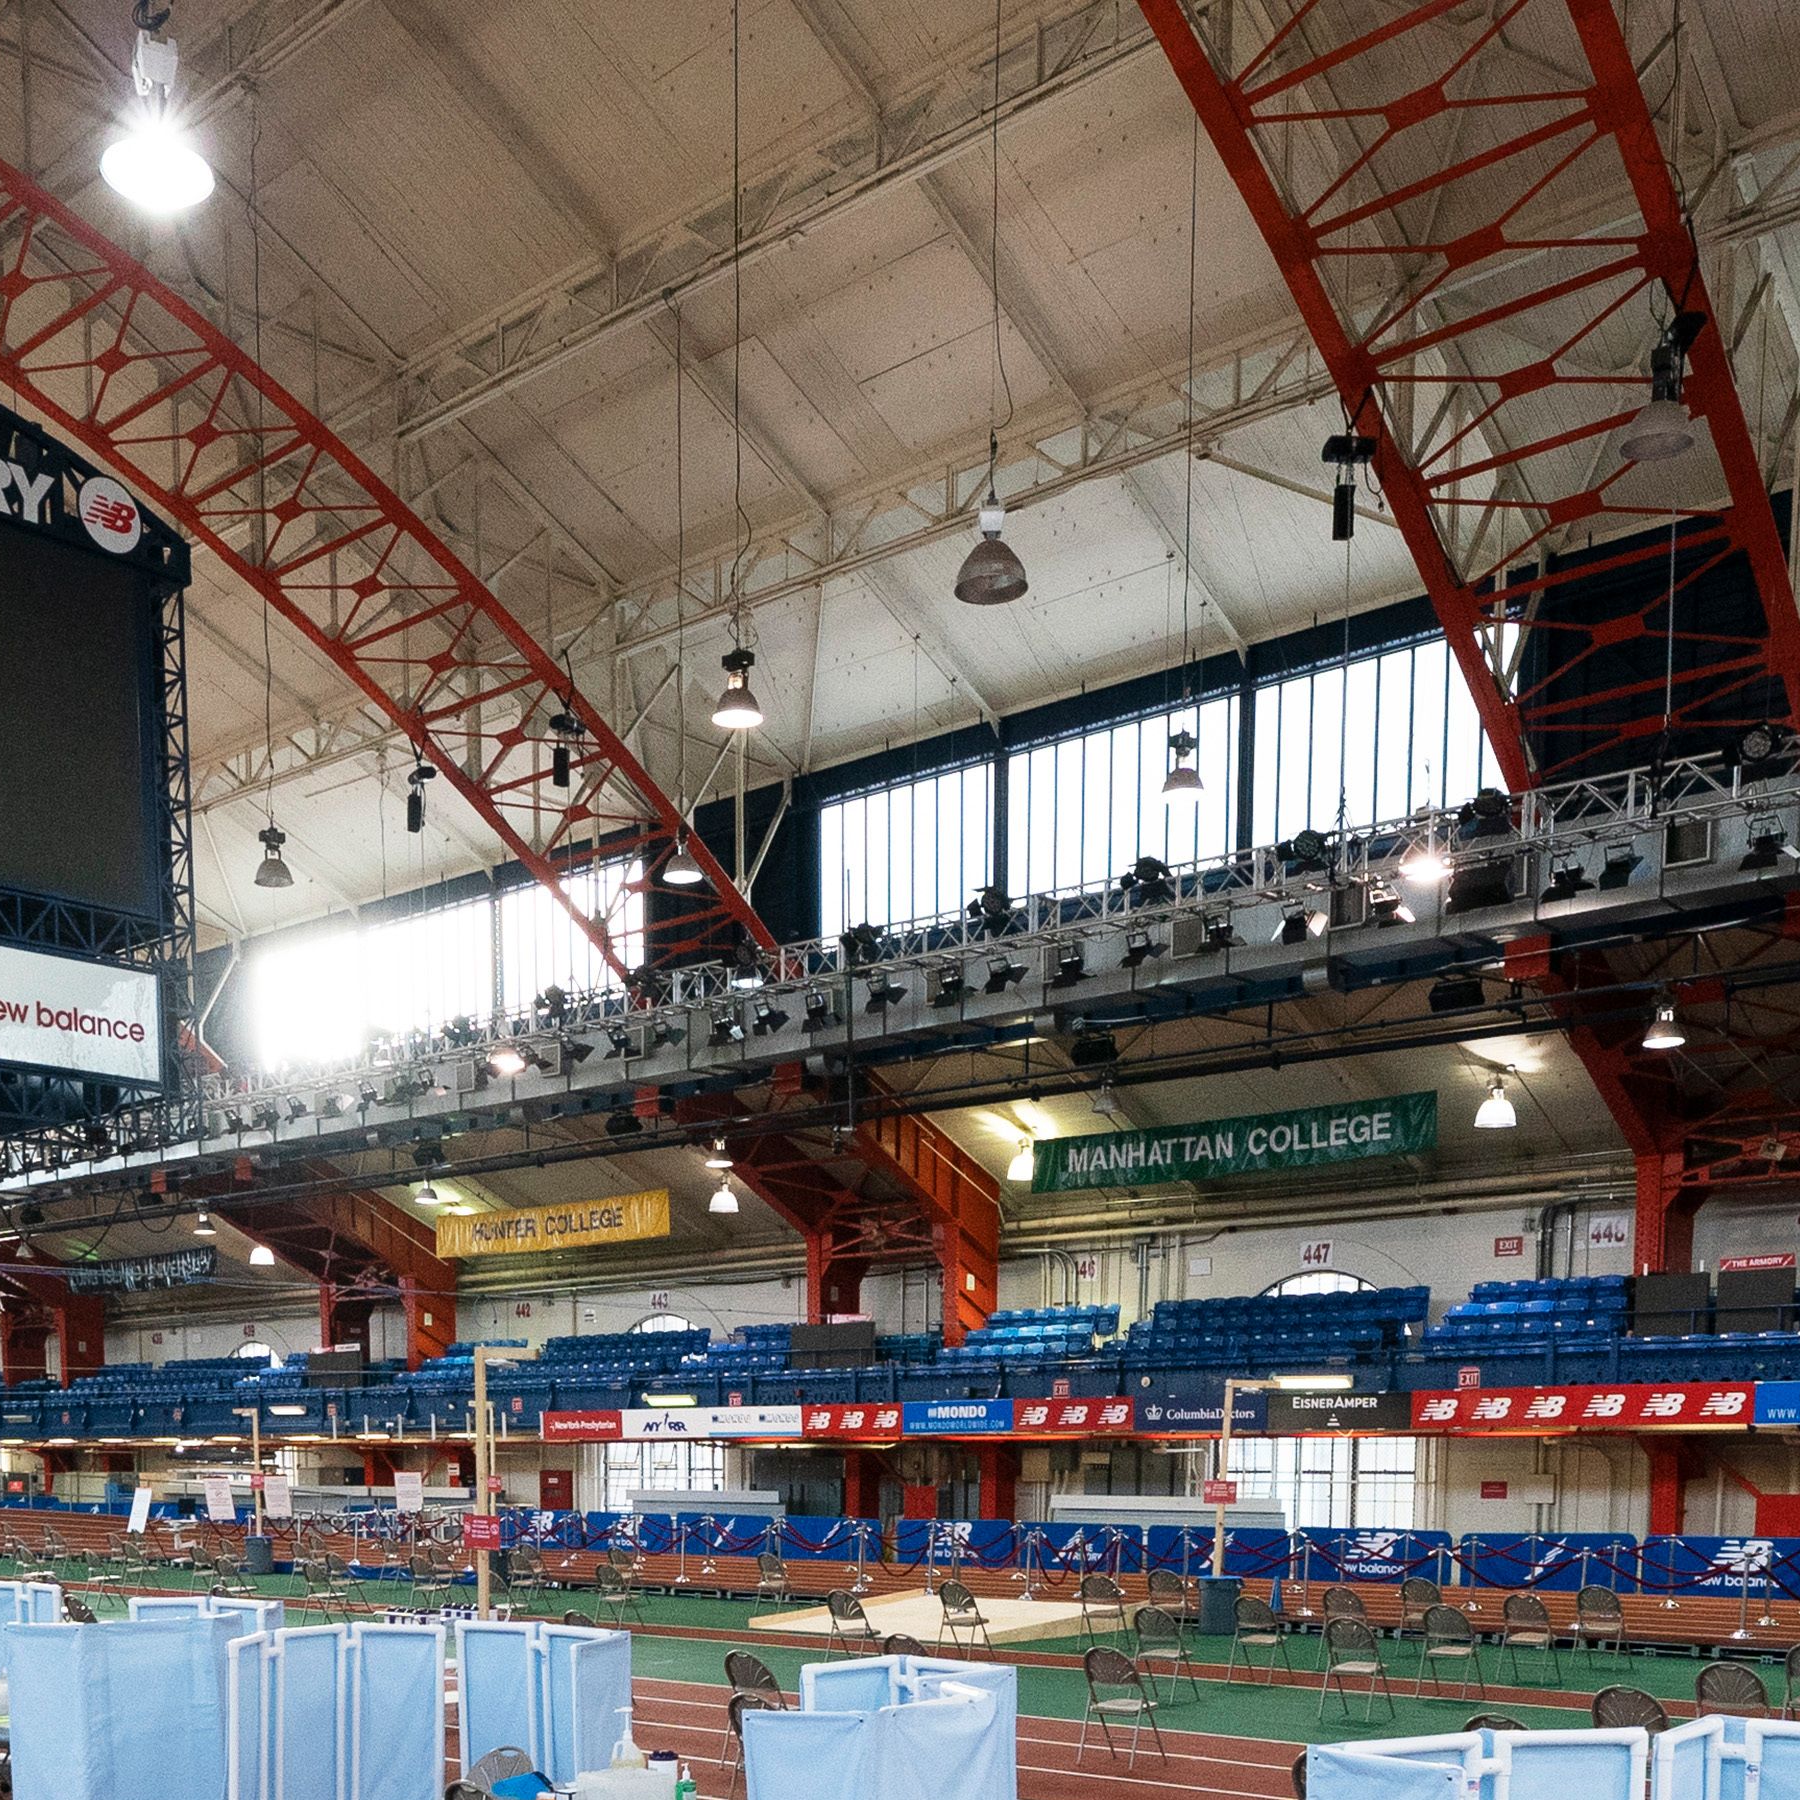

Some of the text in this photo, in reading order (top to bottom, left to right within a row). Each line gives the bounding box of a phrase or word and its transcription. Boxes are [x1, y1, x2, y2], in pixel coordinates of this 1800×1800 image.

[34, 994, 145, 1043] balance
[1068, 1111, 1393, 1174] MANHATTAN COLLEGE
[471, 1206, 624, 1242] HUNTER COLLEGE
[1499, 1239, 1518, 1250] EXIT
[1303, 1243, 1331, 1264] 447
[1731, 1256, 1782, 1269] THE ARMORY
[651, 1293, 669, 1310] 443
[515, 1302, 531, 1319] 442
[1461, 1374, 1480, 1387] EXIT
[937, 1406, 987, 1419] MONDO
[1166, 1407, 1256, 1422] ColumbiaDctors
